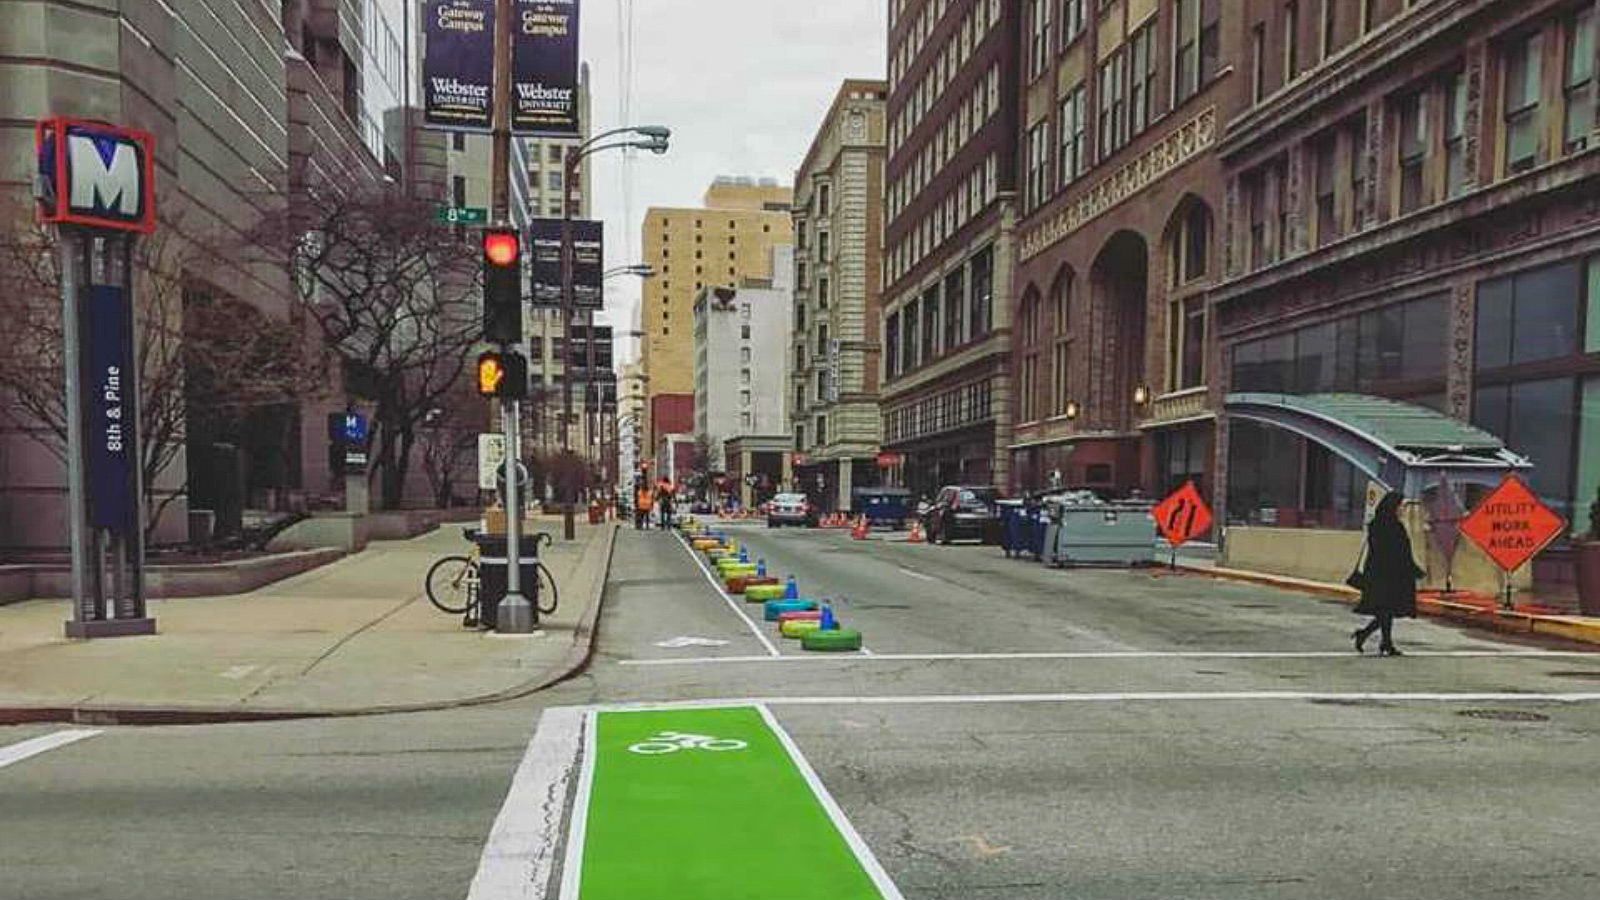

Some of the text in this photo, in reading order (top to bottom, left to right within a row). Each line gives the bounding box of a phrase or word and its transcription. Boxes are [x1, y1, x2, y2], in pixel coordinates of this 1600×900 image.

[431, 78, 489, 97] Webster
[516, 83, 572, 100] Webster
[68, 135, 139, 215] M
[104, 366, 121, 452] 8th & Pine
[1486, 503, 1535, 515] UTILITY
[1493, 520, 1530, 532] WORK
[1488, 537, 1535, 549] AHEAD
